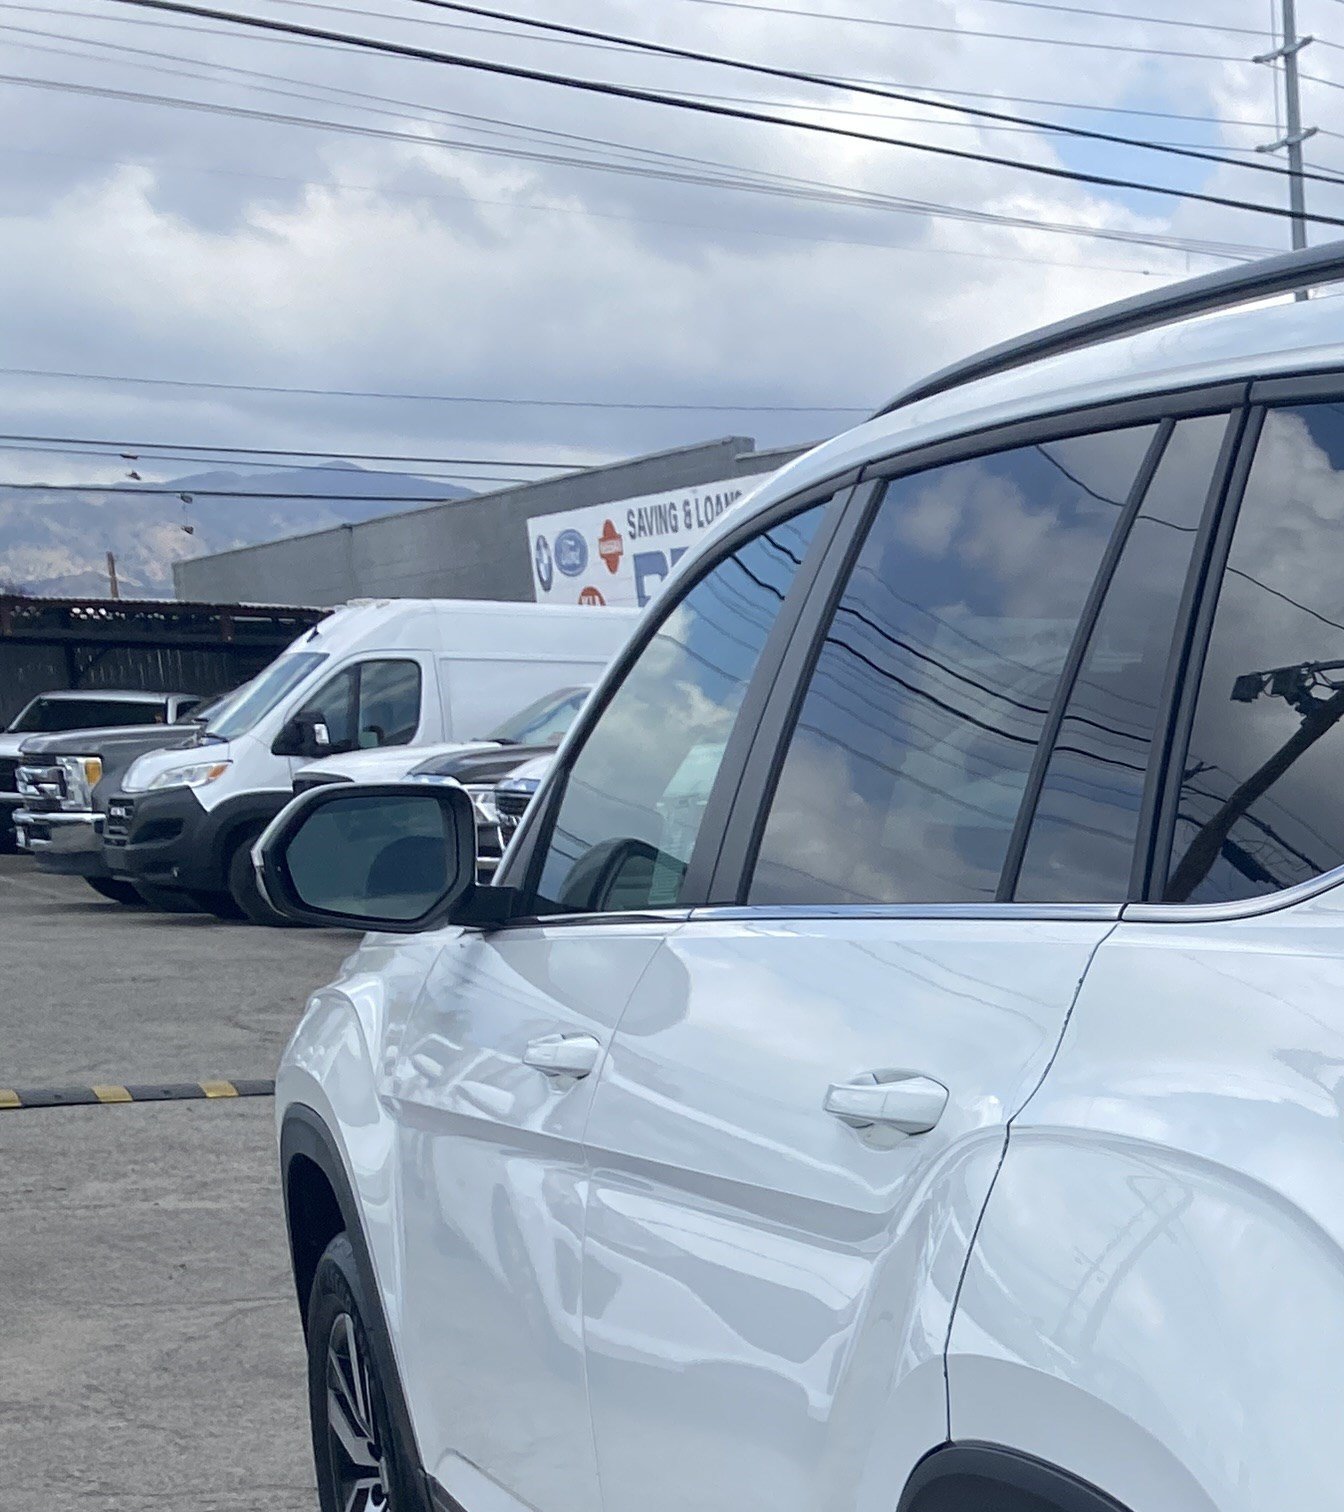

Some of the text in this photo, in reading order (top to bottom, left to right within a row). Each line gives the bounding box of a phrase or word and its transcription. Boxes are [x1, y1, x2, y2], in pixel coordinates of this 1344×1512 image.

[627, 488, 743, 540] SAVING & LOA
